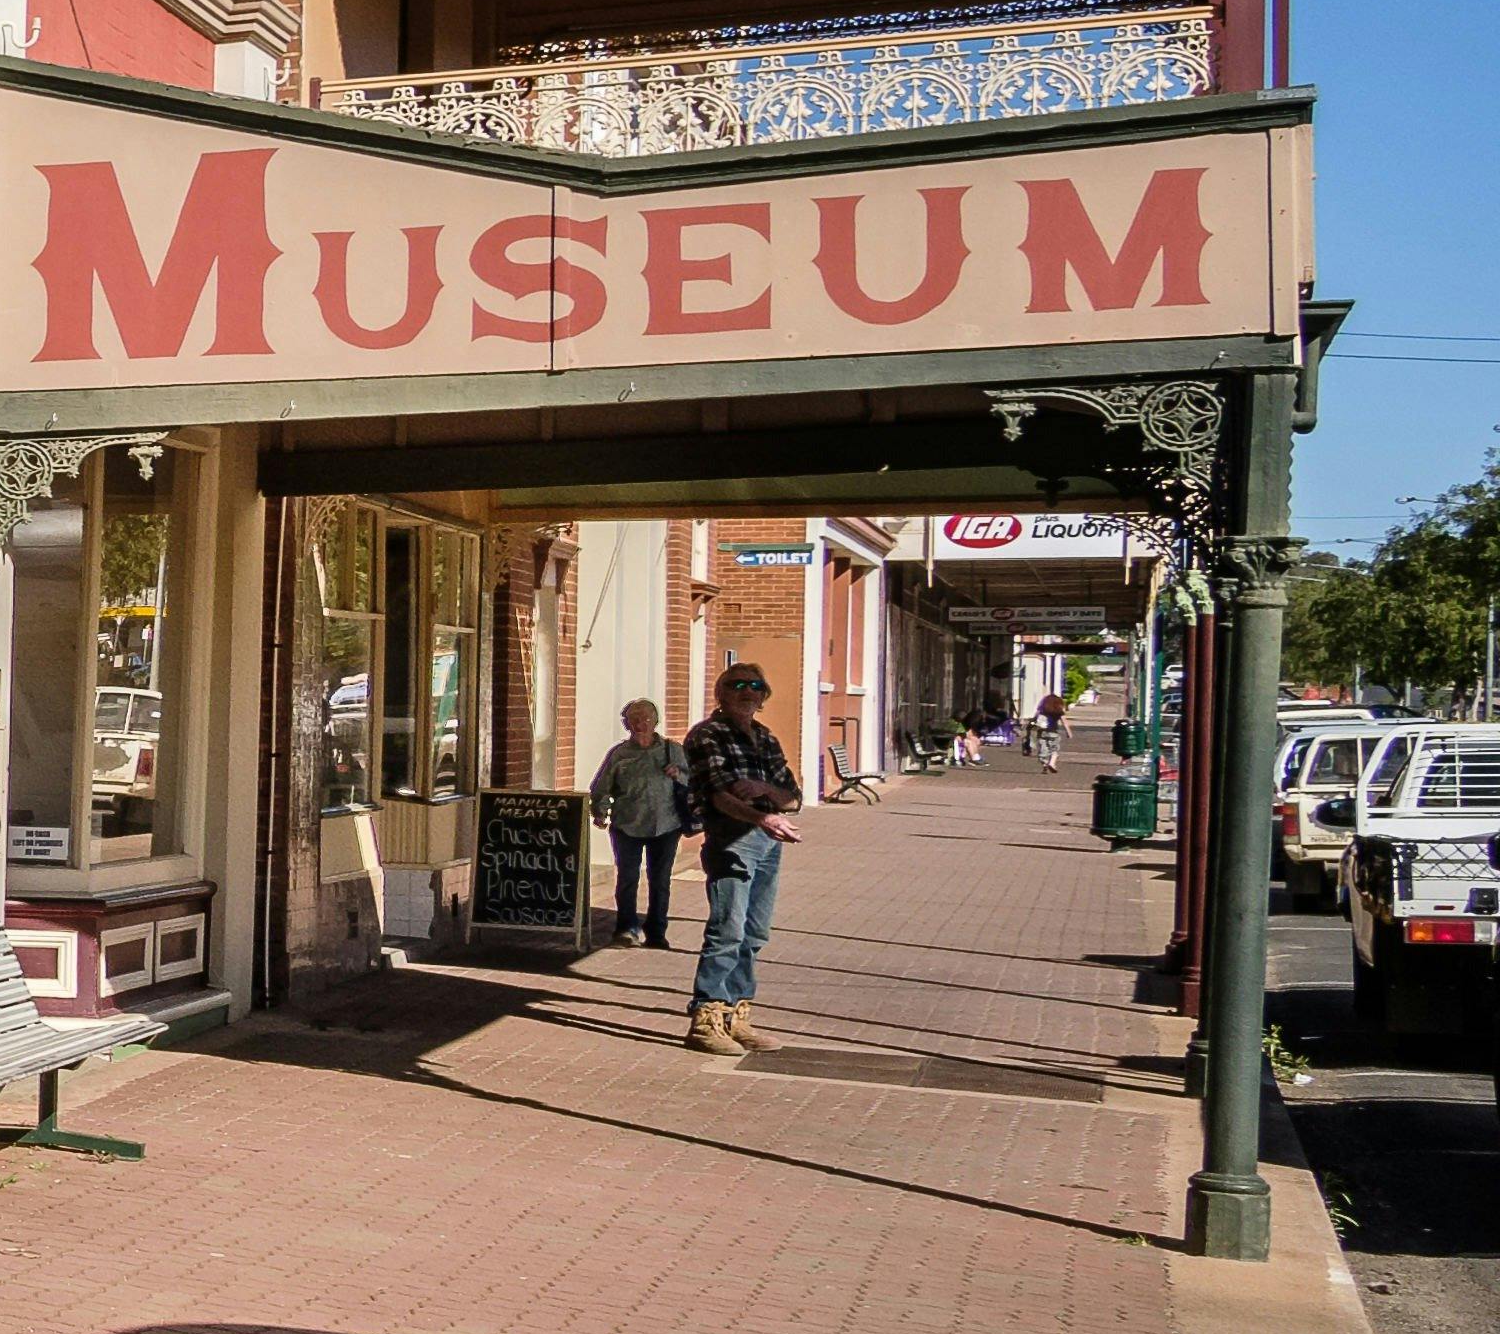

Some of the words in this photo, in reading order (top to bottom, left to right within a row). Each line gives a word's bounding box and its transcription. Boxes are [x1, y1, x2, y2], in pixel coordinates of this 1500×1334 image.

[31, 148, 1212, 362] MUSEUM
[952, 516, 1014, 540] IGA
[756, 552, 810, 564] TOILET
[494, 797, 568, 809] MANILLA
[498, 809, 559, 820] MEATS
[486, 819, 568, 847] Chicken
[481, 843, 563, 873] Spinach
[486, 869, 572, 904] Pinenut
